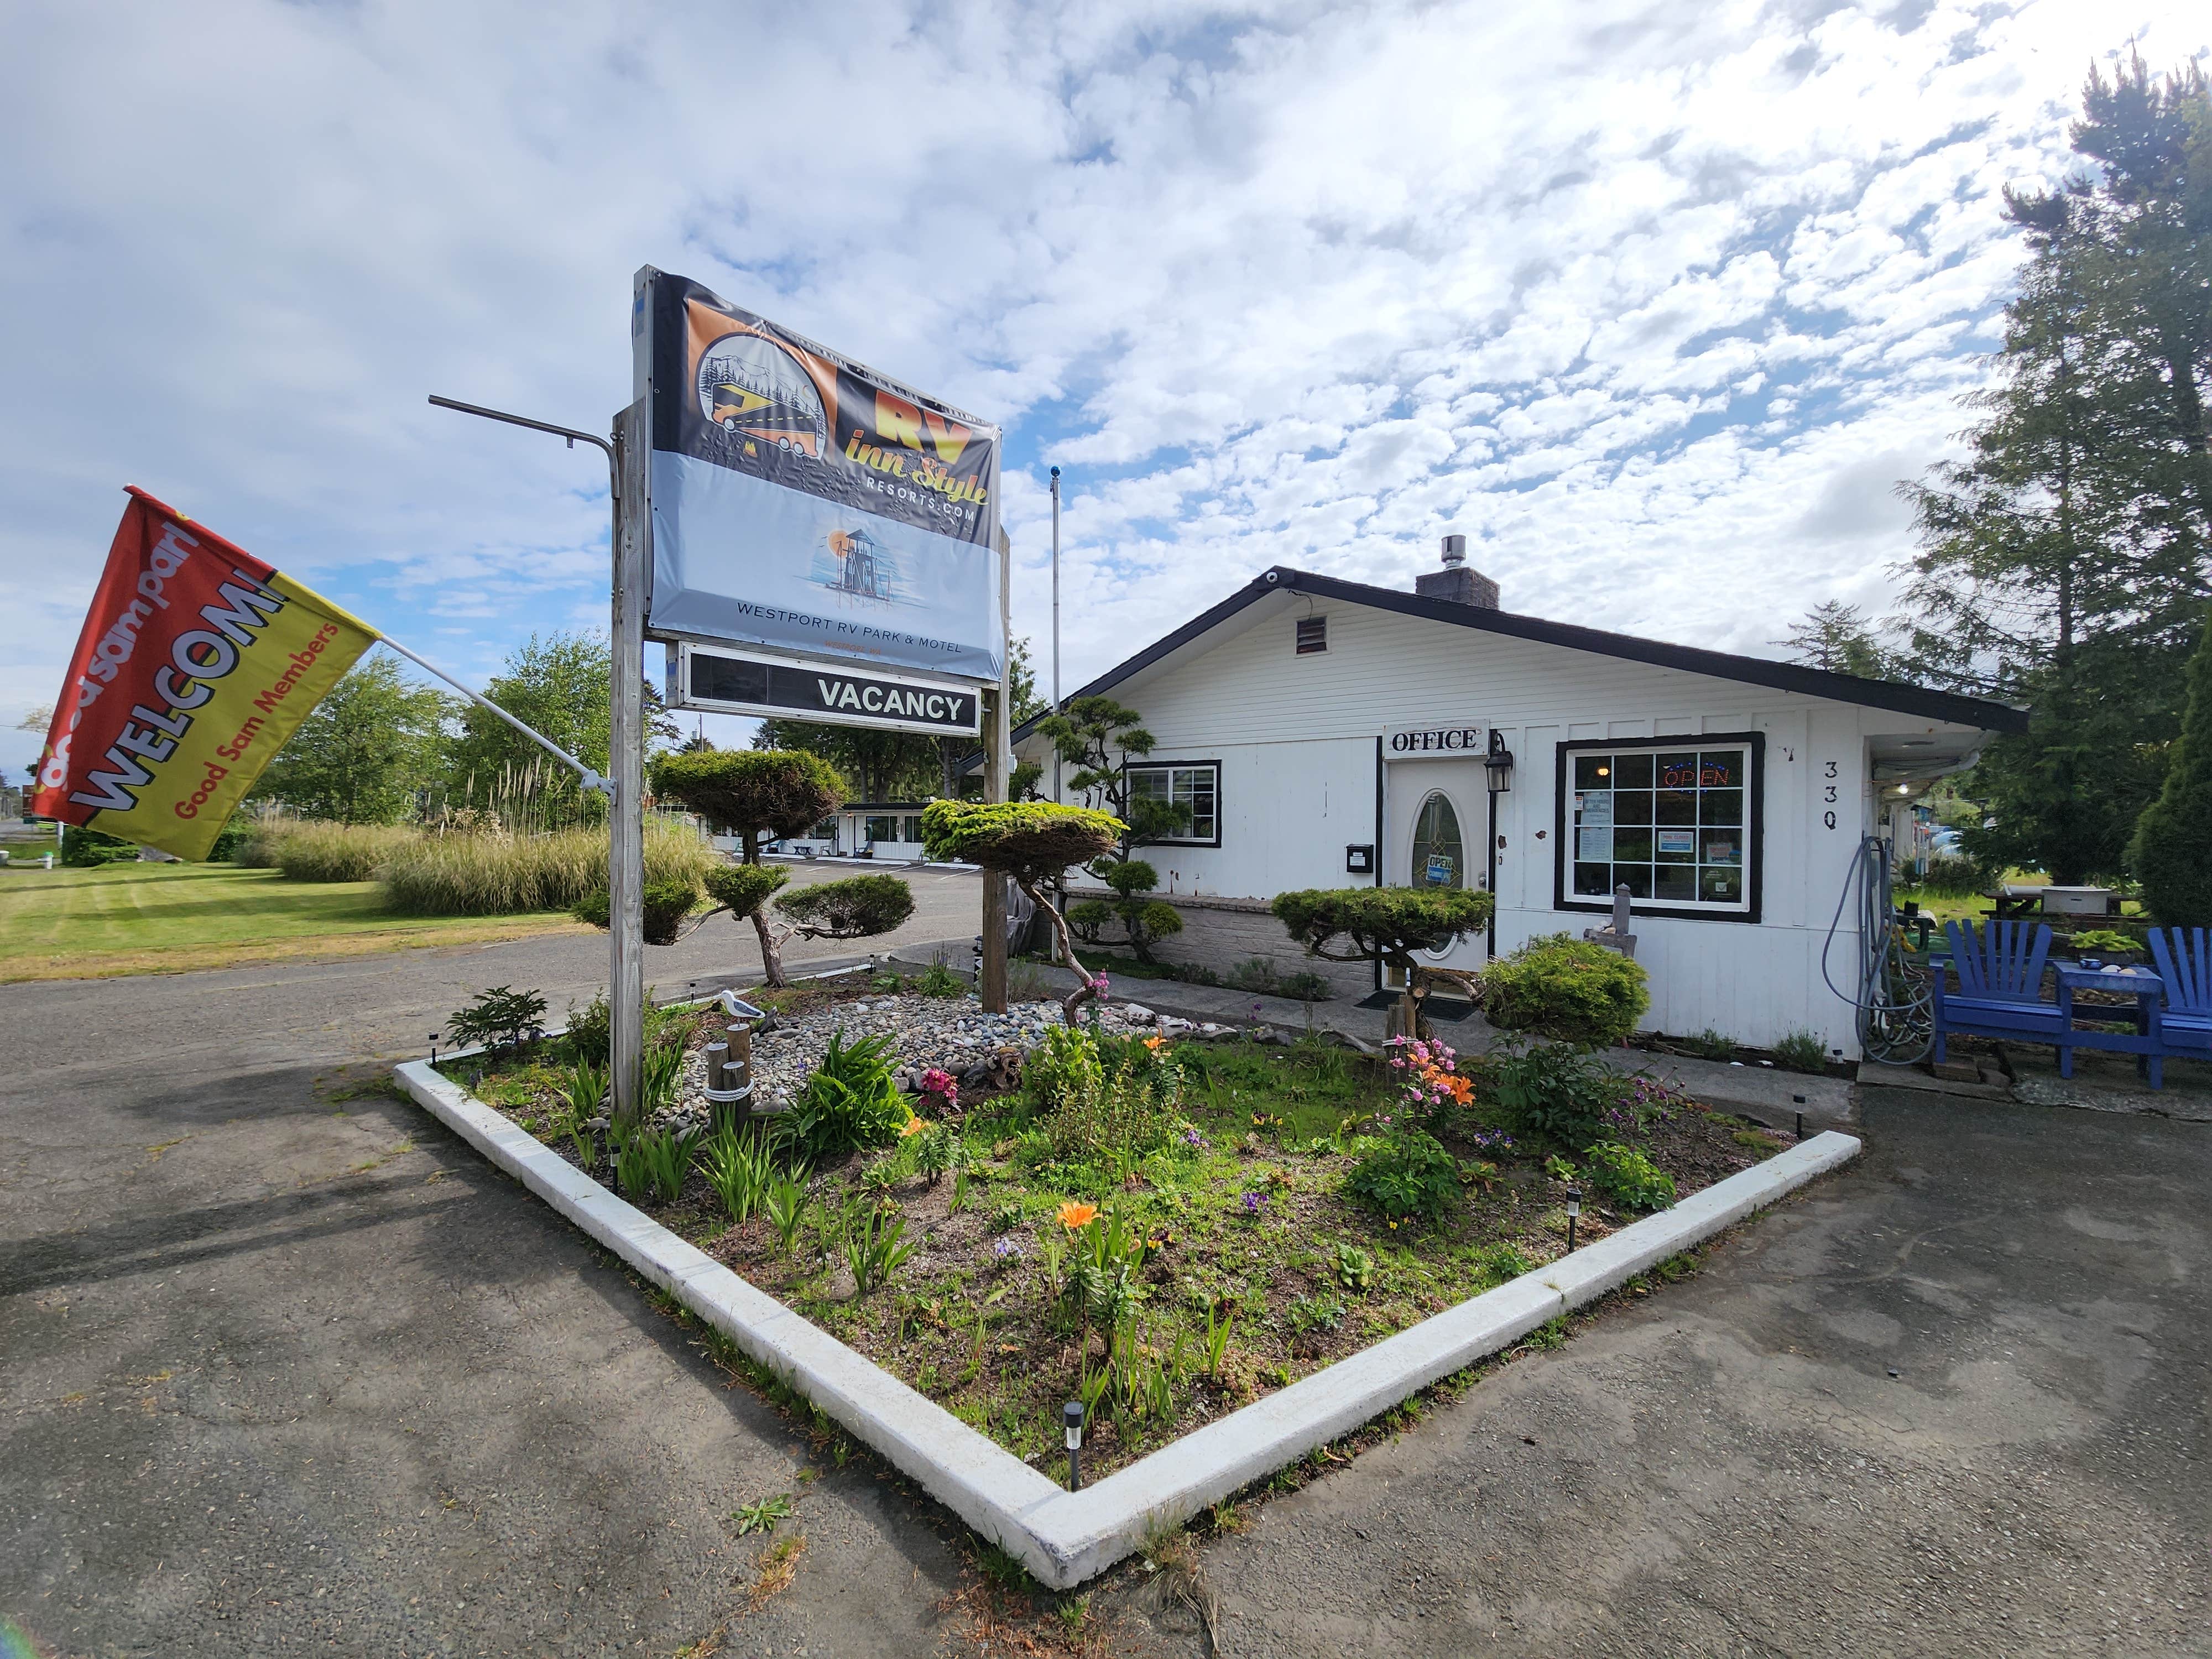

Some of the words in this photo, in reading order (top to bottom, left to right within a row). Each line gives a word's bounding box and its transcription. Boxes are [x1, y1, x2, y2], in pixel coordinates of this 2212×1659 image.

[875, 389, 973, 465] RV
[846, 429, 907, 478] inn
[912, 457, 989, 505] Style
[866, 476, 975, 521] RESORTS.COM
[87, 598, 154, 683] sam
[737, 602, 832, 630] WESTPORT
[837, 622, 858, 634] RV
[863, 627, 900, 643] PARK
[905, 635, 914, 645] &
[919, 637, 962, 653] MOTEL
[174, 761, 229, 820] Good
[216, 715, 265, 761] Sam
[252, 623, 339, 714] Members
[817, 679, 963, 721] VACANCY
[1392, 729, 1477, 752] OFFICE
[1664, 769, 1729, 786] OPEN
[1430, 857, 1452, 869] OPEN
